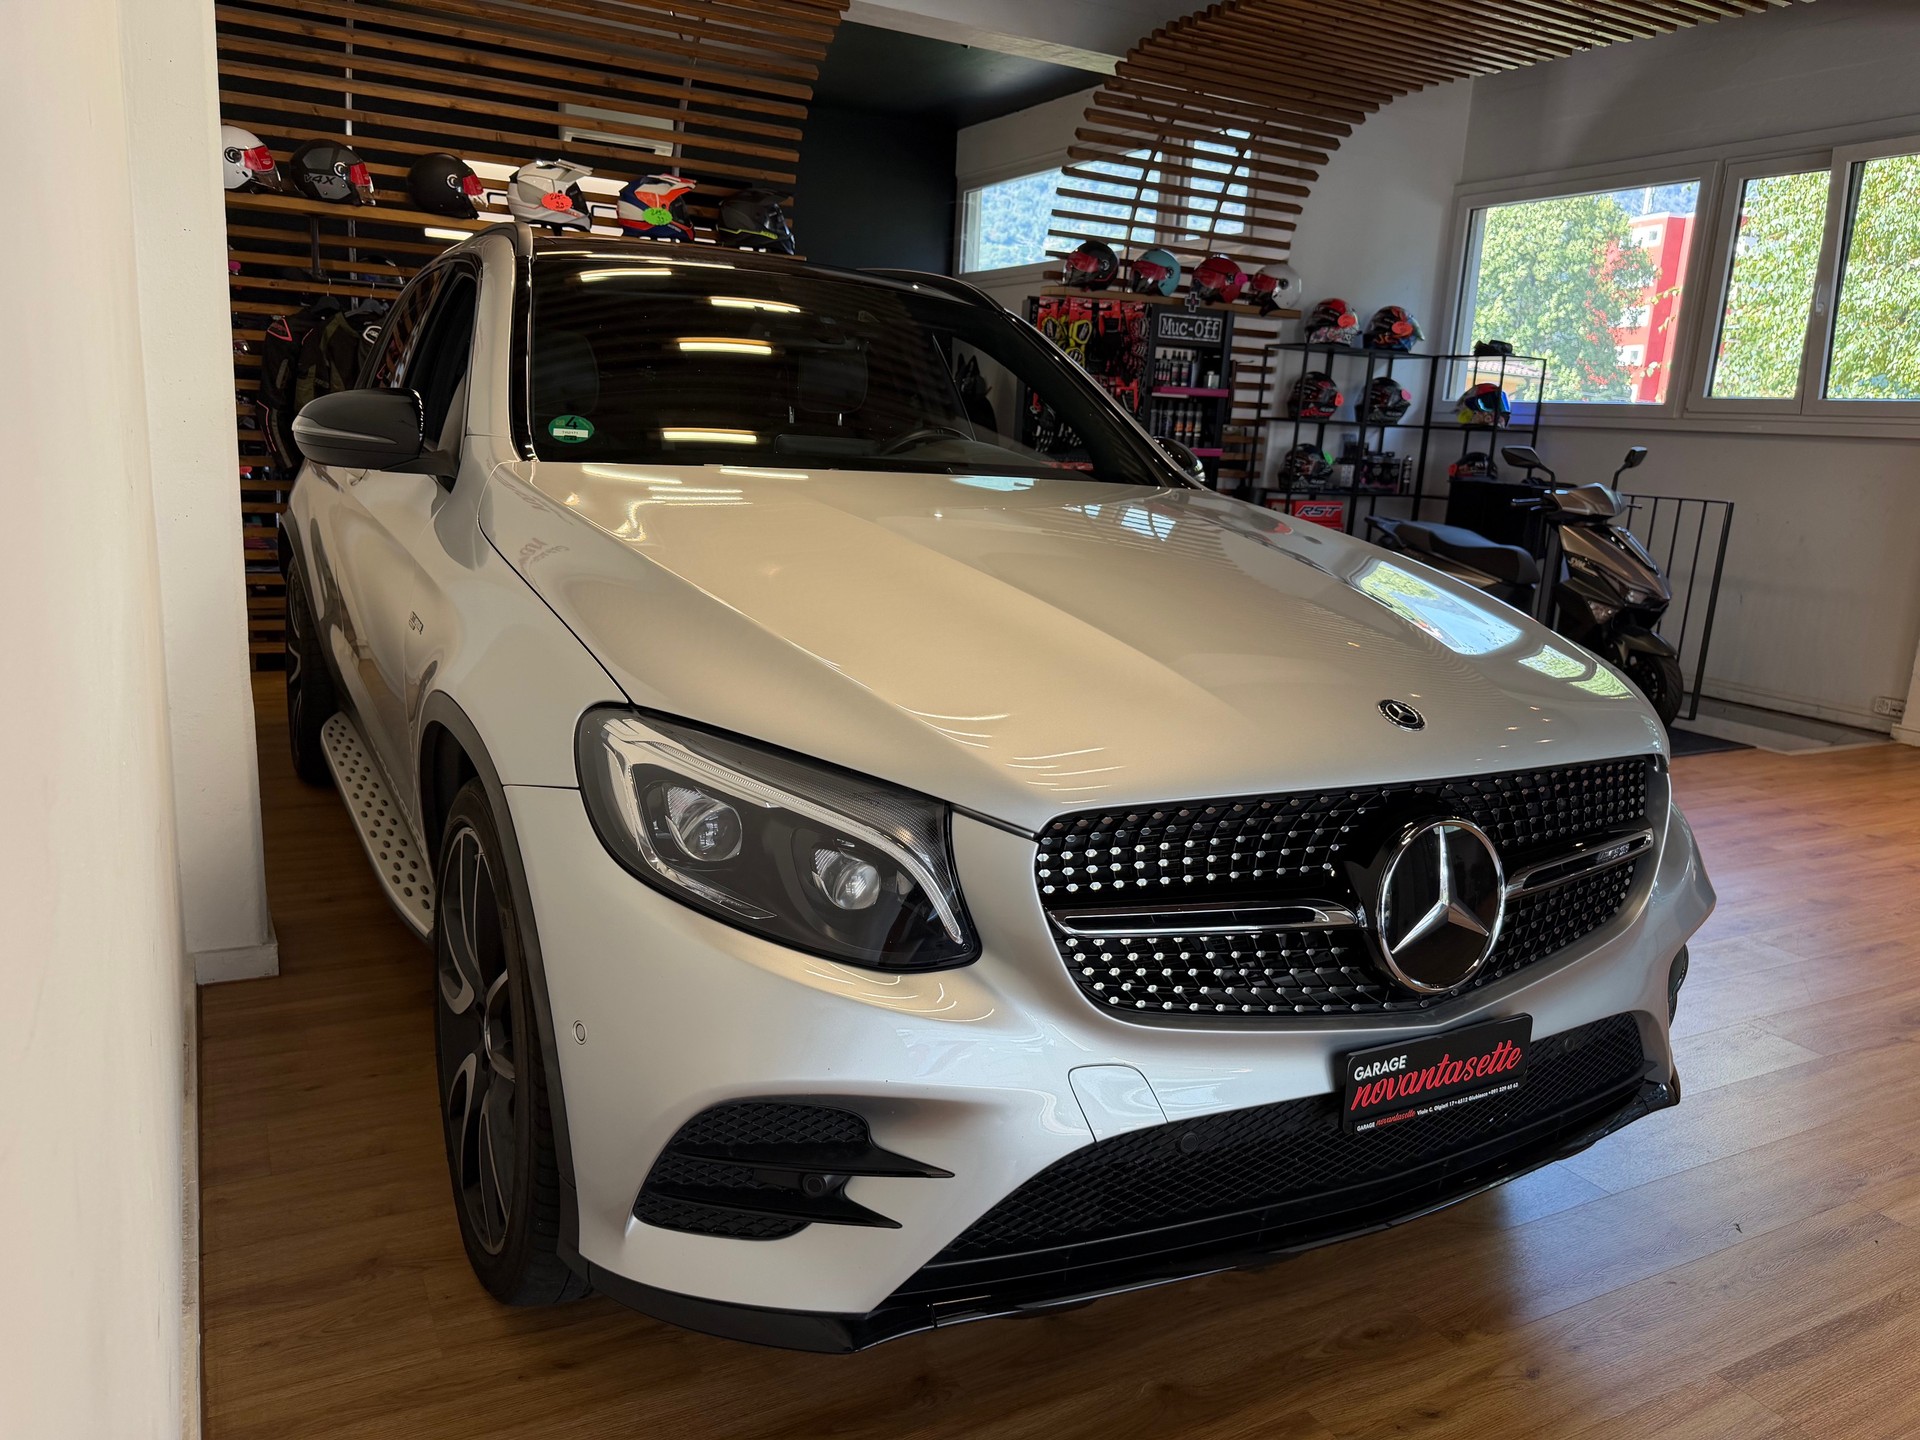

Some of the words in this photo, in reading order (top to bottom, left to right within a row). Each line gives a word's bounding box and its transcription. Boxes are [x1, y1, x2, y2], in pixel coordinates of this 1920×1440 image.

[303, 173, 337, 186] V4X
[1161, 317, 1220, 339] Muc-Off
[565, 416, 578, 430] 4
[1295, 504, 1343, 518] RST
[1350, 1039, 1523, 1111] novantasette
[1354, 1054, 1408, 1082] GARAGE
[1356, 1121, 1376, 1132] GARAGE
